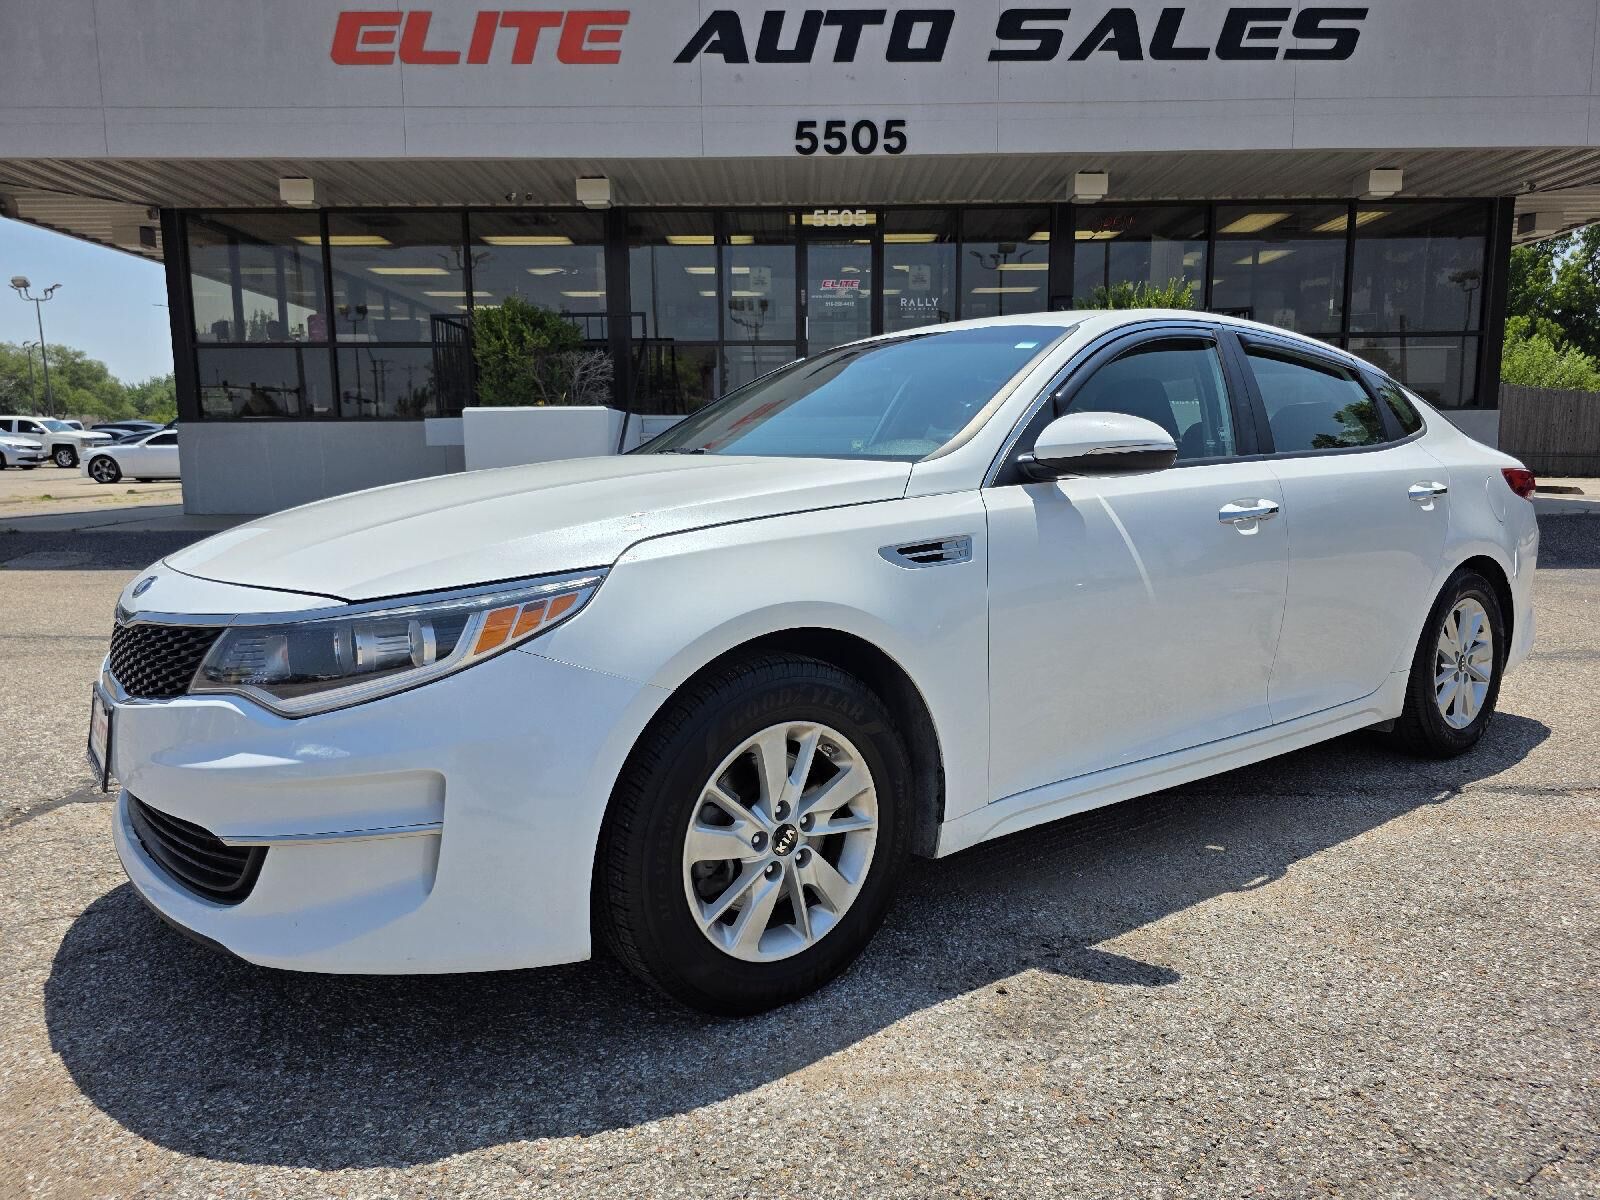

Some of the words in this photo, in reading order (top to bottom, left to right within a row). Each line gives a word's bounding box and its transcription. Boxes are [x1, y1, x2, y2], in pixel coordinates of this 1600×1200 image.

[331, 10, 630, 65] ELITE
[673, 9, 955, 64] AUTO
[988, 7, 1369, 62] SALES
[794, 119, 908, 156] 5505
[813, 209, 867, 227] 5505
[821, 279, 860, 289] ELITE
[900, 297, 939, 307] RALLY
[775, 829, 796, 854] KIA
